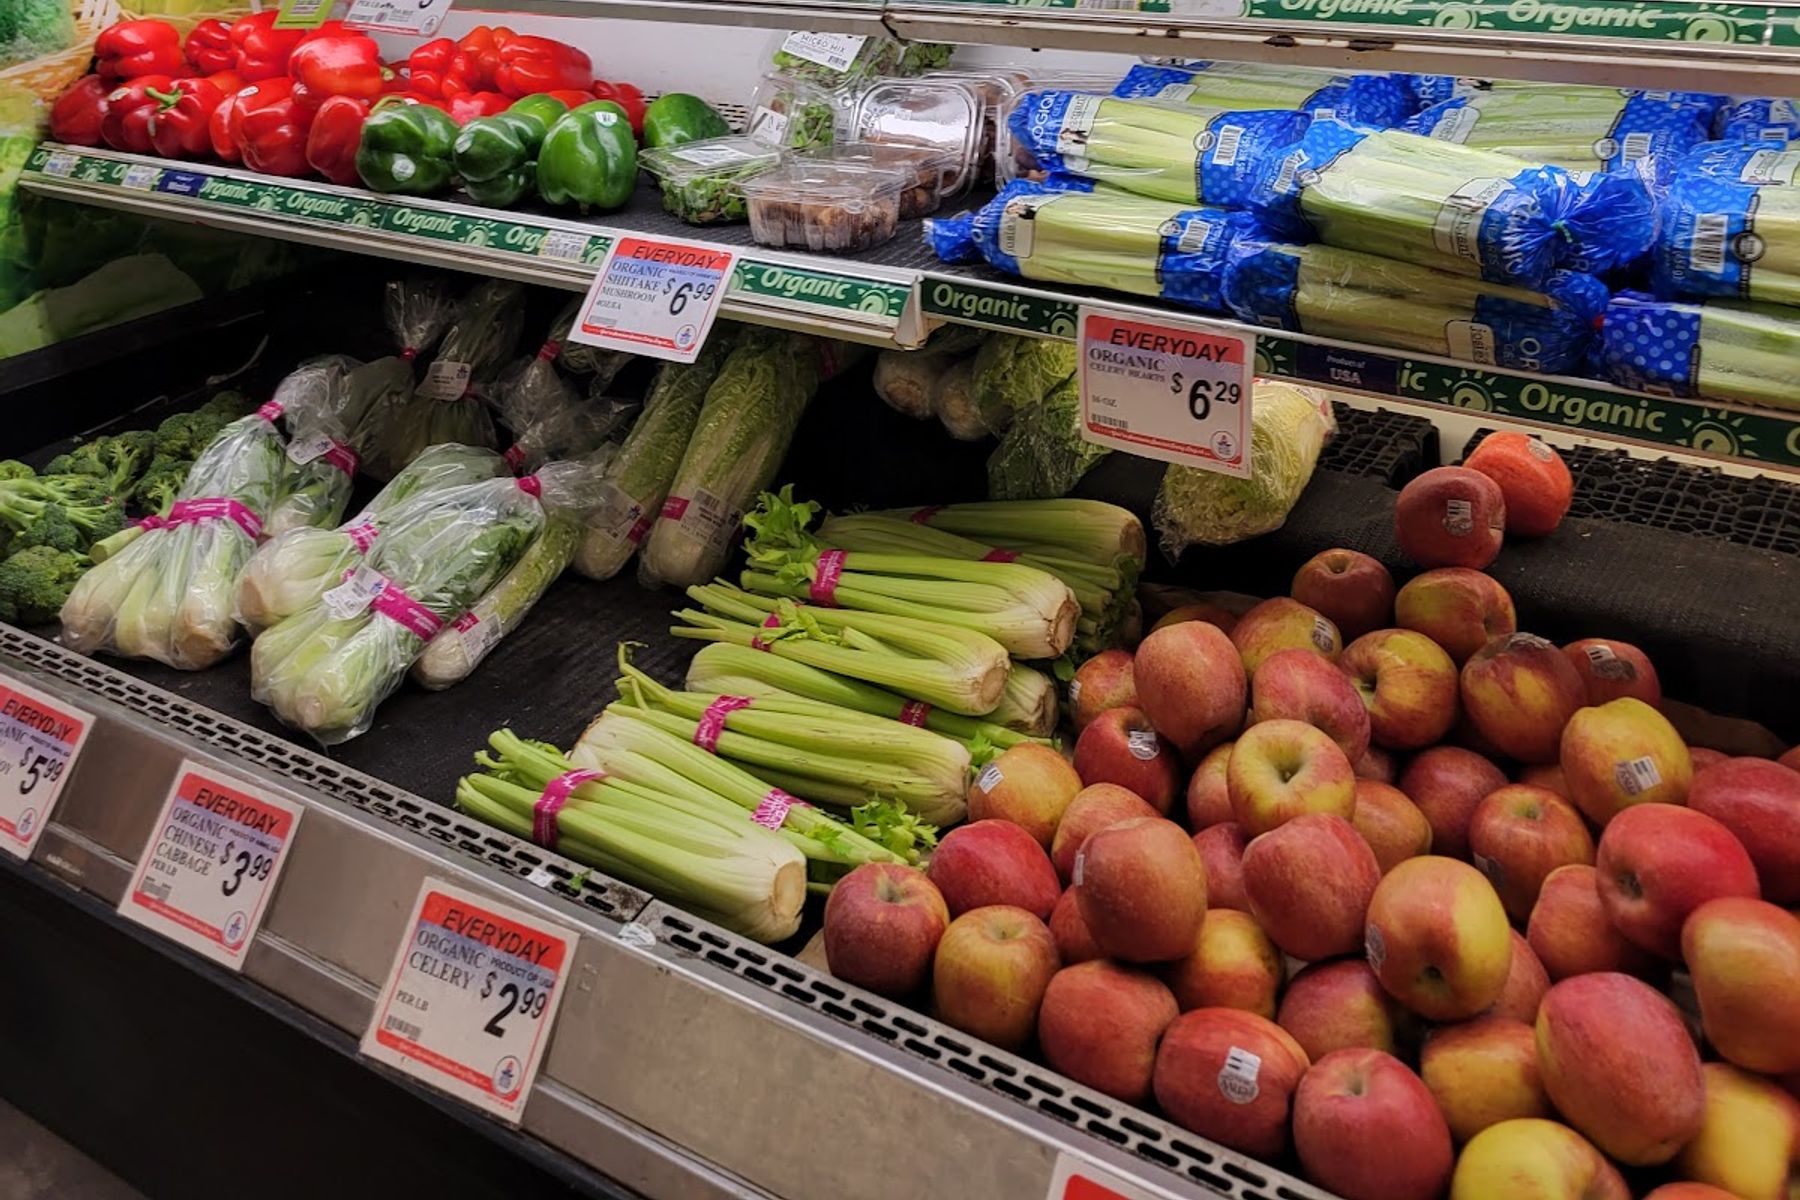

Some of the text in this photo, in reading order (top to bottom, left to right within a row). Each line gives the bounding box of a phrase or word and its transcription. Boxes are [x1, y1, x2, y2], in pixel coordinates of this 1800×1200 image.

[285, 192, 349, 217] Organic
[391, 208, 461, 236] Organic
[612, 261, 667, 279] ORGANIC
[632, 245, 718, 268] EVERYDAY
[601, 285, 656, 303] MUSHROOM
[761, 267, 850, 301] Organic
[933, 284, 1030, 323] Organic
[1090, 348, 1165, 372] ORGANIC
[1110, 328, 1228, 362] EVERYDAY
[1090, 362, 1125, 377] CELERY
[1329, 367, 1362, 384] USA
[1520, 383, 1667, 433] Organic
[1, 699, 74, 742] EVERYDAY
[172, 807, 230, 840] ORGANIC
[193, 788, 280, 836] EVERYDAY
[164, 824, 219, 860] CHINESE
[156, 842, 212, 876] CABBAGE
[416, 929, 487, 969] ORGANIC
[441, 908, 551, 966] EVERYDAY
[409, 951, 475, 990] CELERY
[490, 957, 528, 978] PRODUCT
[527, 971, 538, 982] OF
[396, 990, 416, 1008] PER
